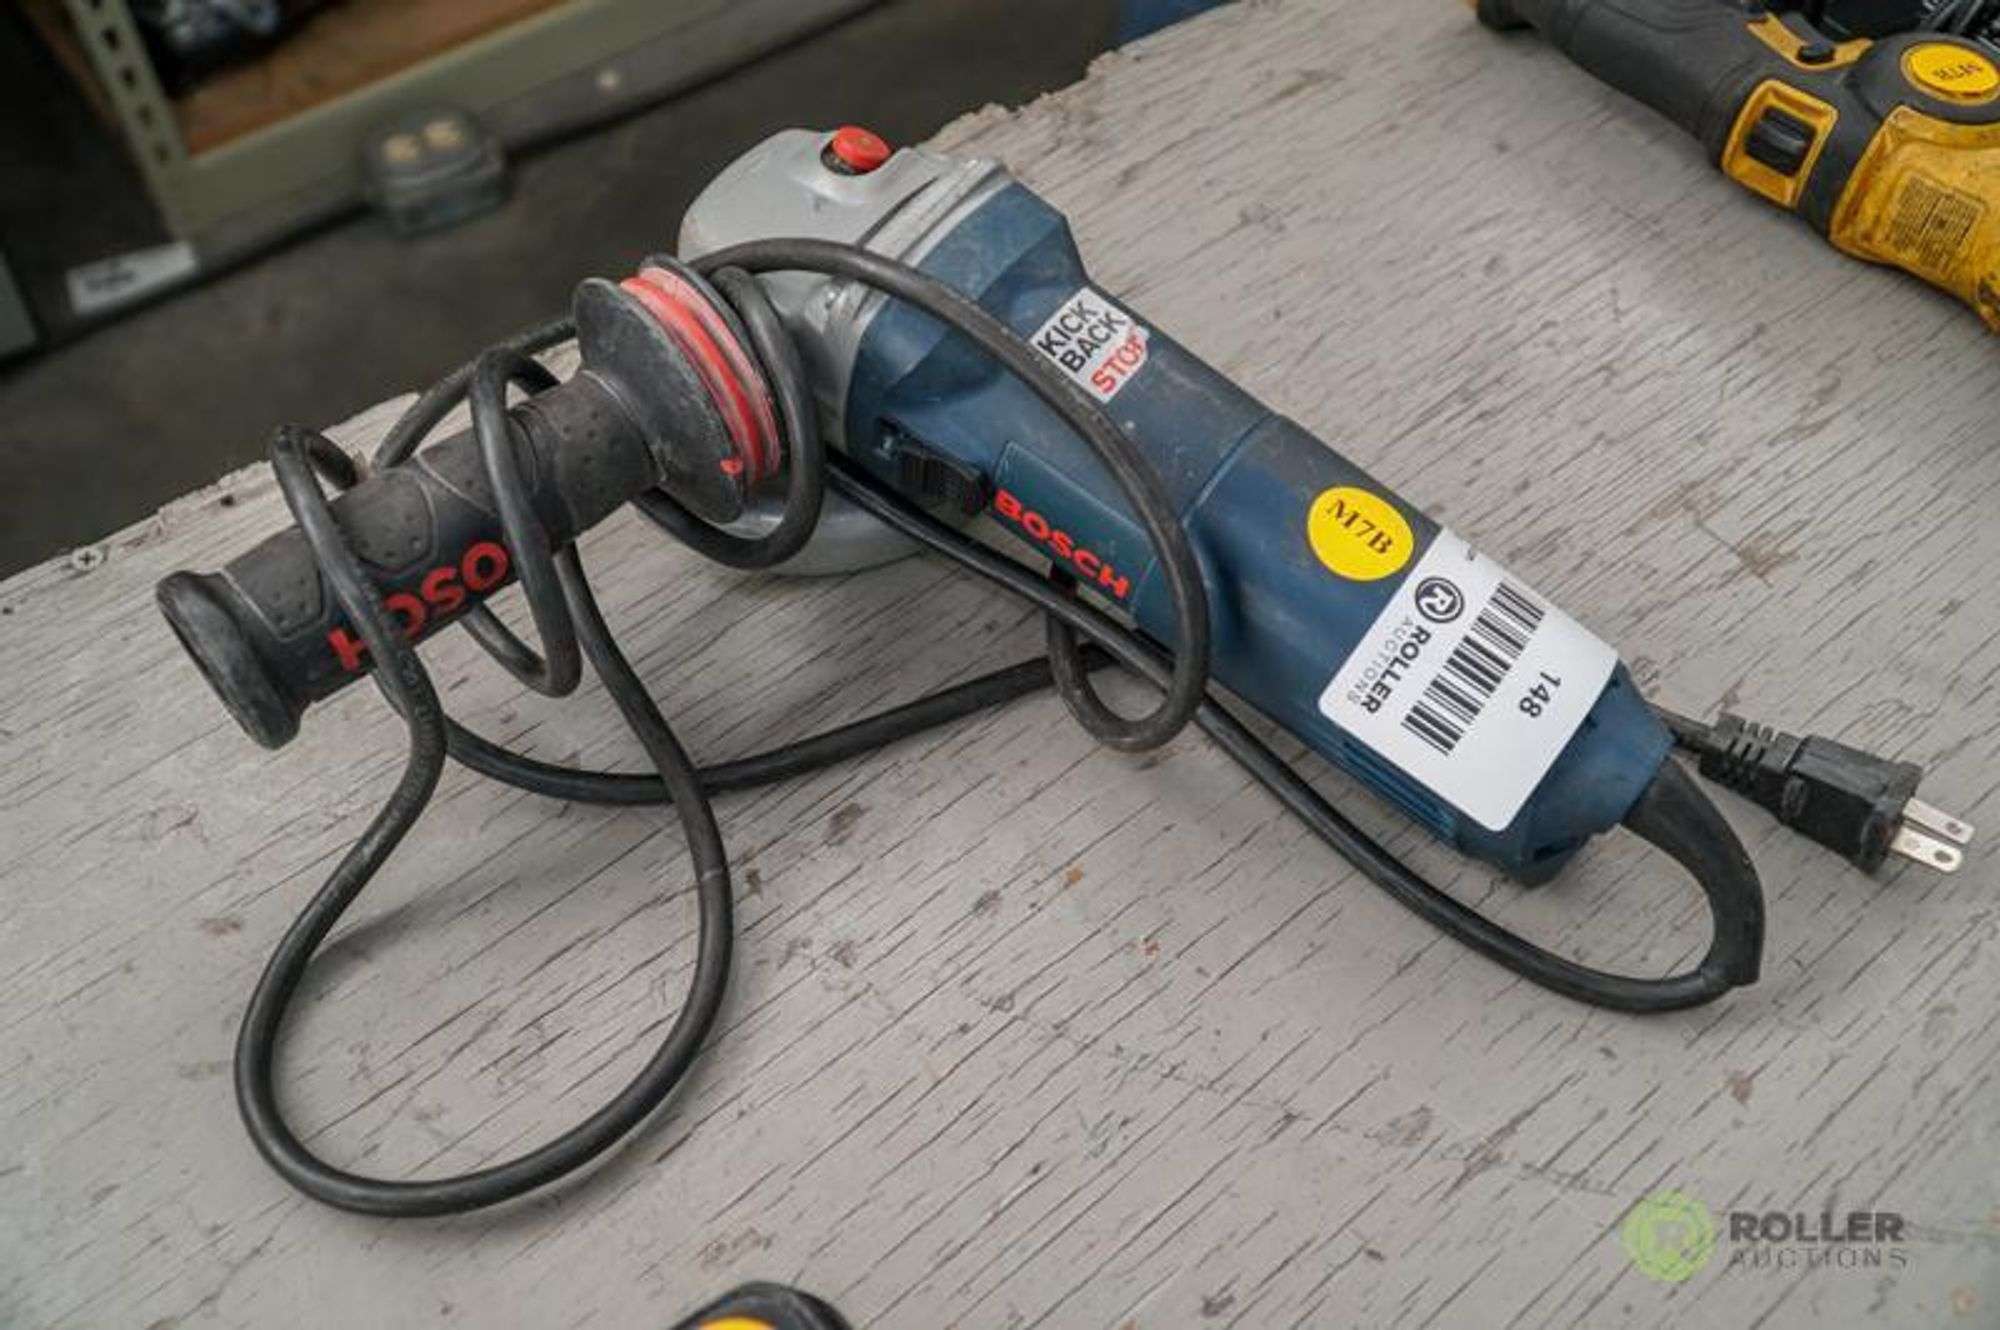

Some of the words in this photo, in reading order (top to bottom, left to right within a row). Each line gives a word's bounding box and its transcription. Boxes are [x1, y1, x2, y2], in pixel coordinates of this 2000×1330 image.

[1037, 301, 1098, 356] KICK
[1060, 312, 1126, 373] BACK
[994, 488, 1131, 599] BOSCH
[1326, 500, 1393, 554] M7B
[327, 541, 509, 671] OSCH
[1347, 615, 1414, 703] AUCTIONS
[1361, 624, 1432, 714] ROLLER
[1519, 671, 1562, 718] 148
